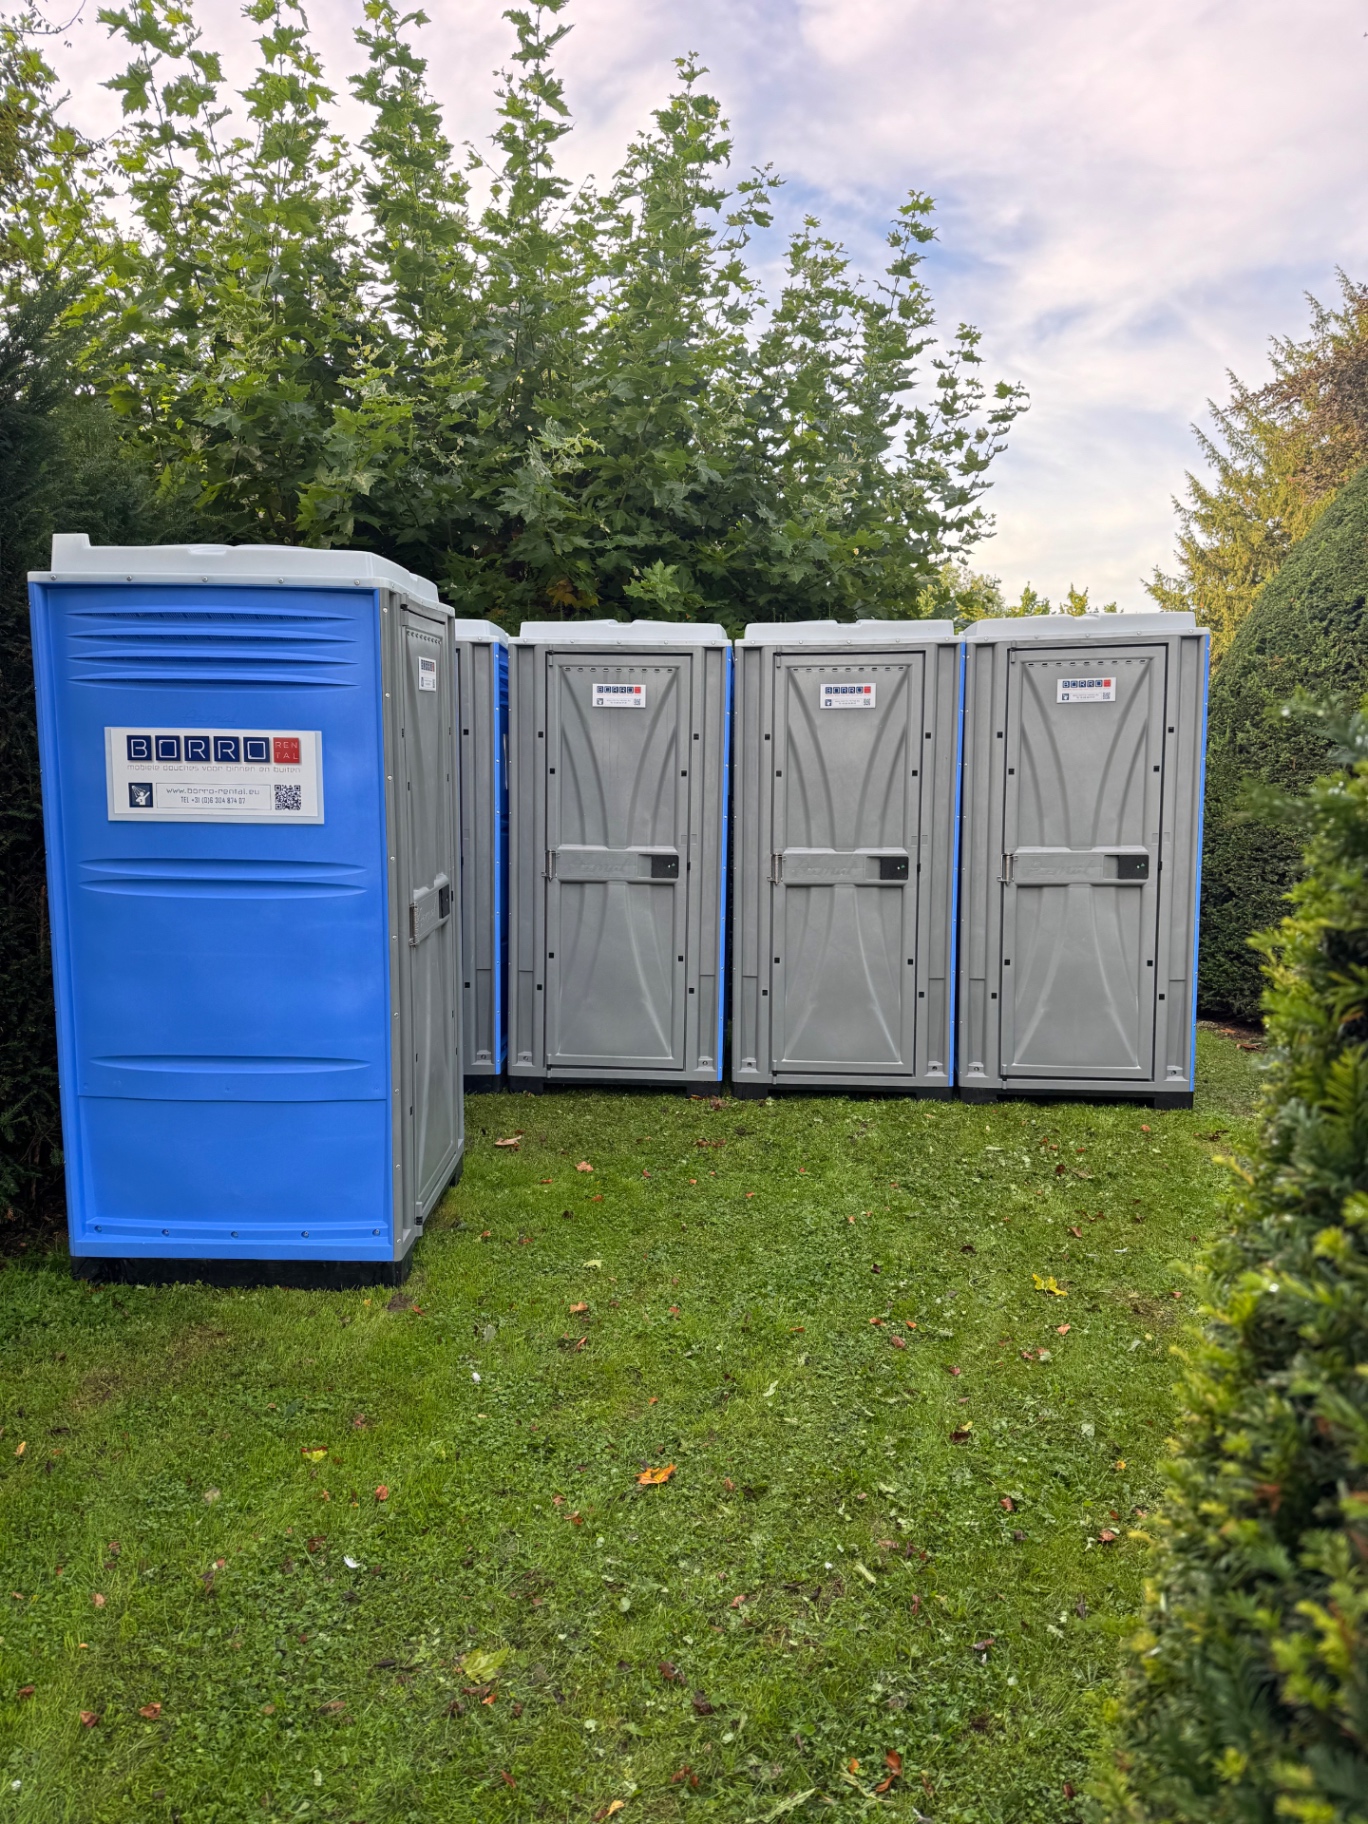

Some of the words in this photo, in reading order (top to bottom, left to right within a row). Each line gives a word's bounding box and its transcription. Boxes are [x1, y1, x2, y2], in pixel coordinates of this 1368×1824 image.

[1062, 680, 1103, 688] BORRO
[825, 686, 864, 694] BORRO
[129, 737, 268, 761] BORRO
[274, 741, 298, 749] REN
[275, 752, 299, 760] TAL
[162, 764, 200, 772] douches
[166, 787, 260, 795] www.borro-rental.eu
[180, 796, 190, 804] TEL
